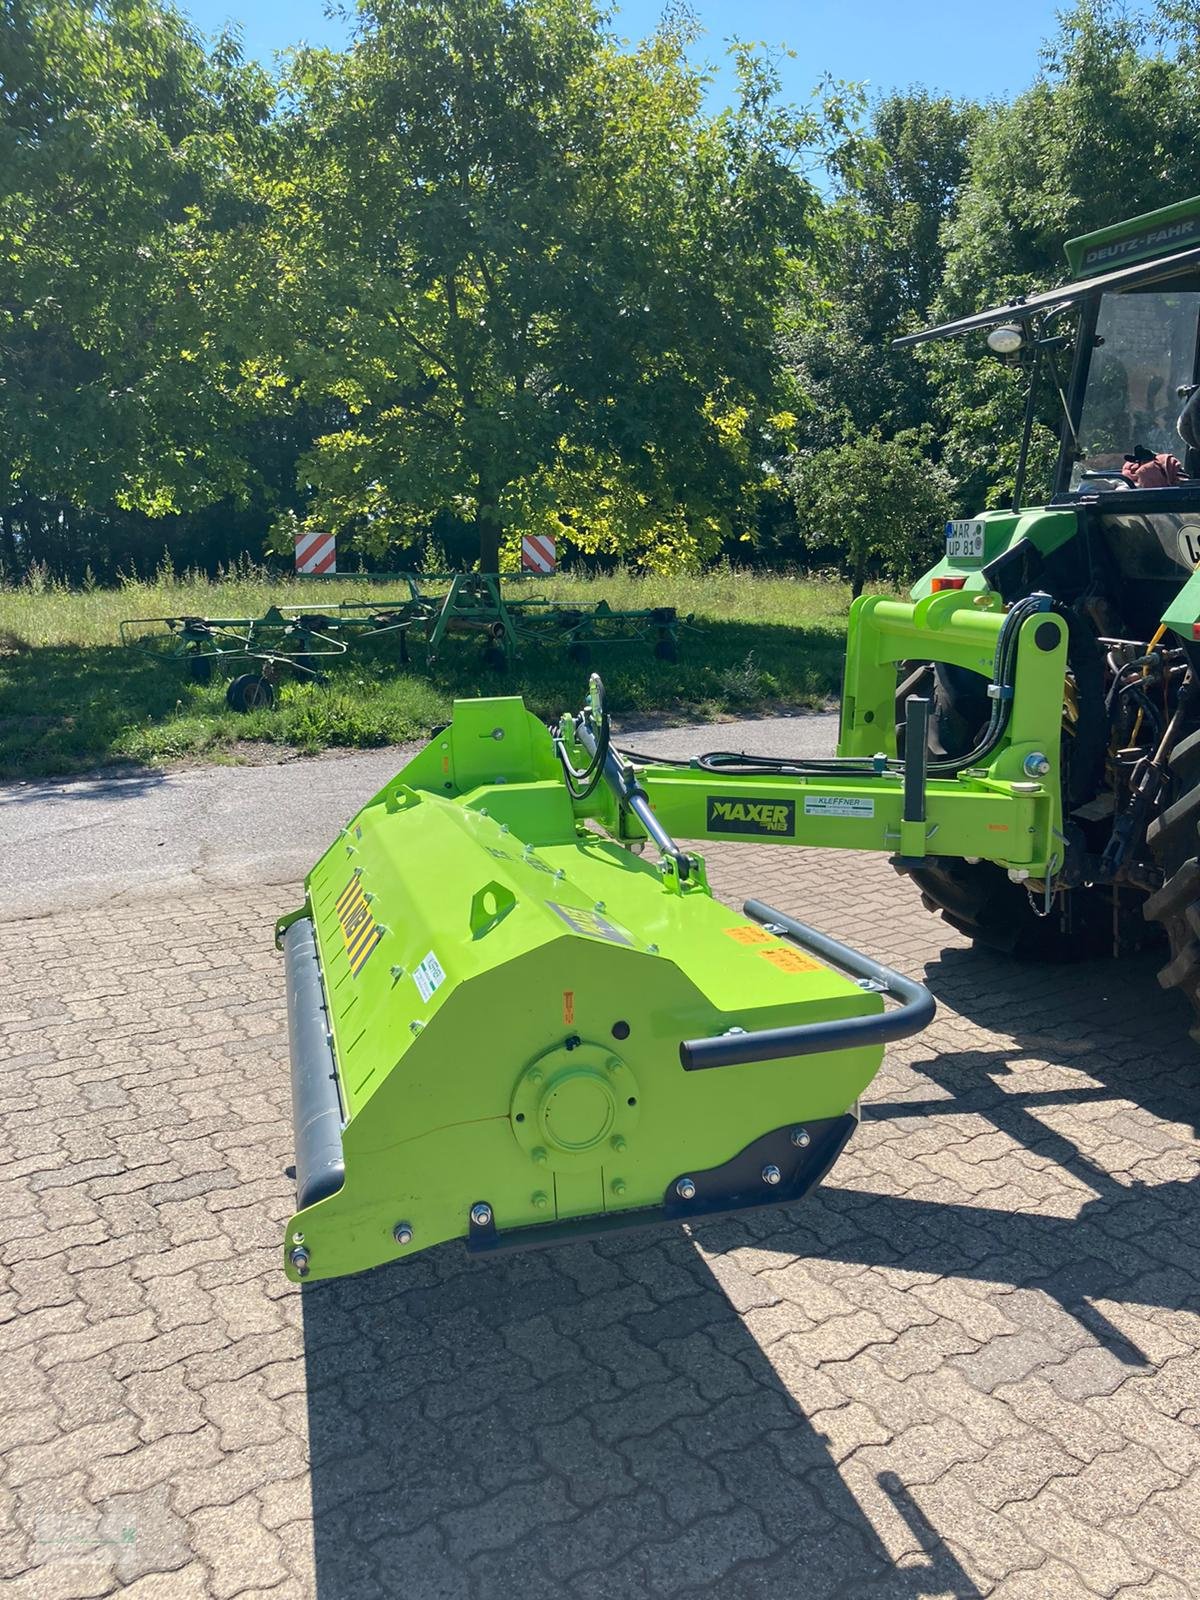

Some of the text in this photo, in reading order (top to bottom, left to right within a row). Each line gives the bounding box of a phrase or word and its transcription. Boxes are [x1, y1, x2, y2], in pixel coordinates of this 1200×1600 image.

[1086, 221, 1195, 264] DEUTZ-FAHR
[948, 540, 975, 555] UP 81
[818, 797, 861, 806] KLEFFNER
[711, 802, 789, 823] MAXER
